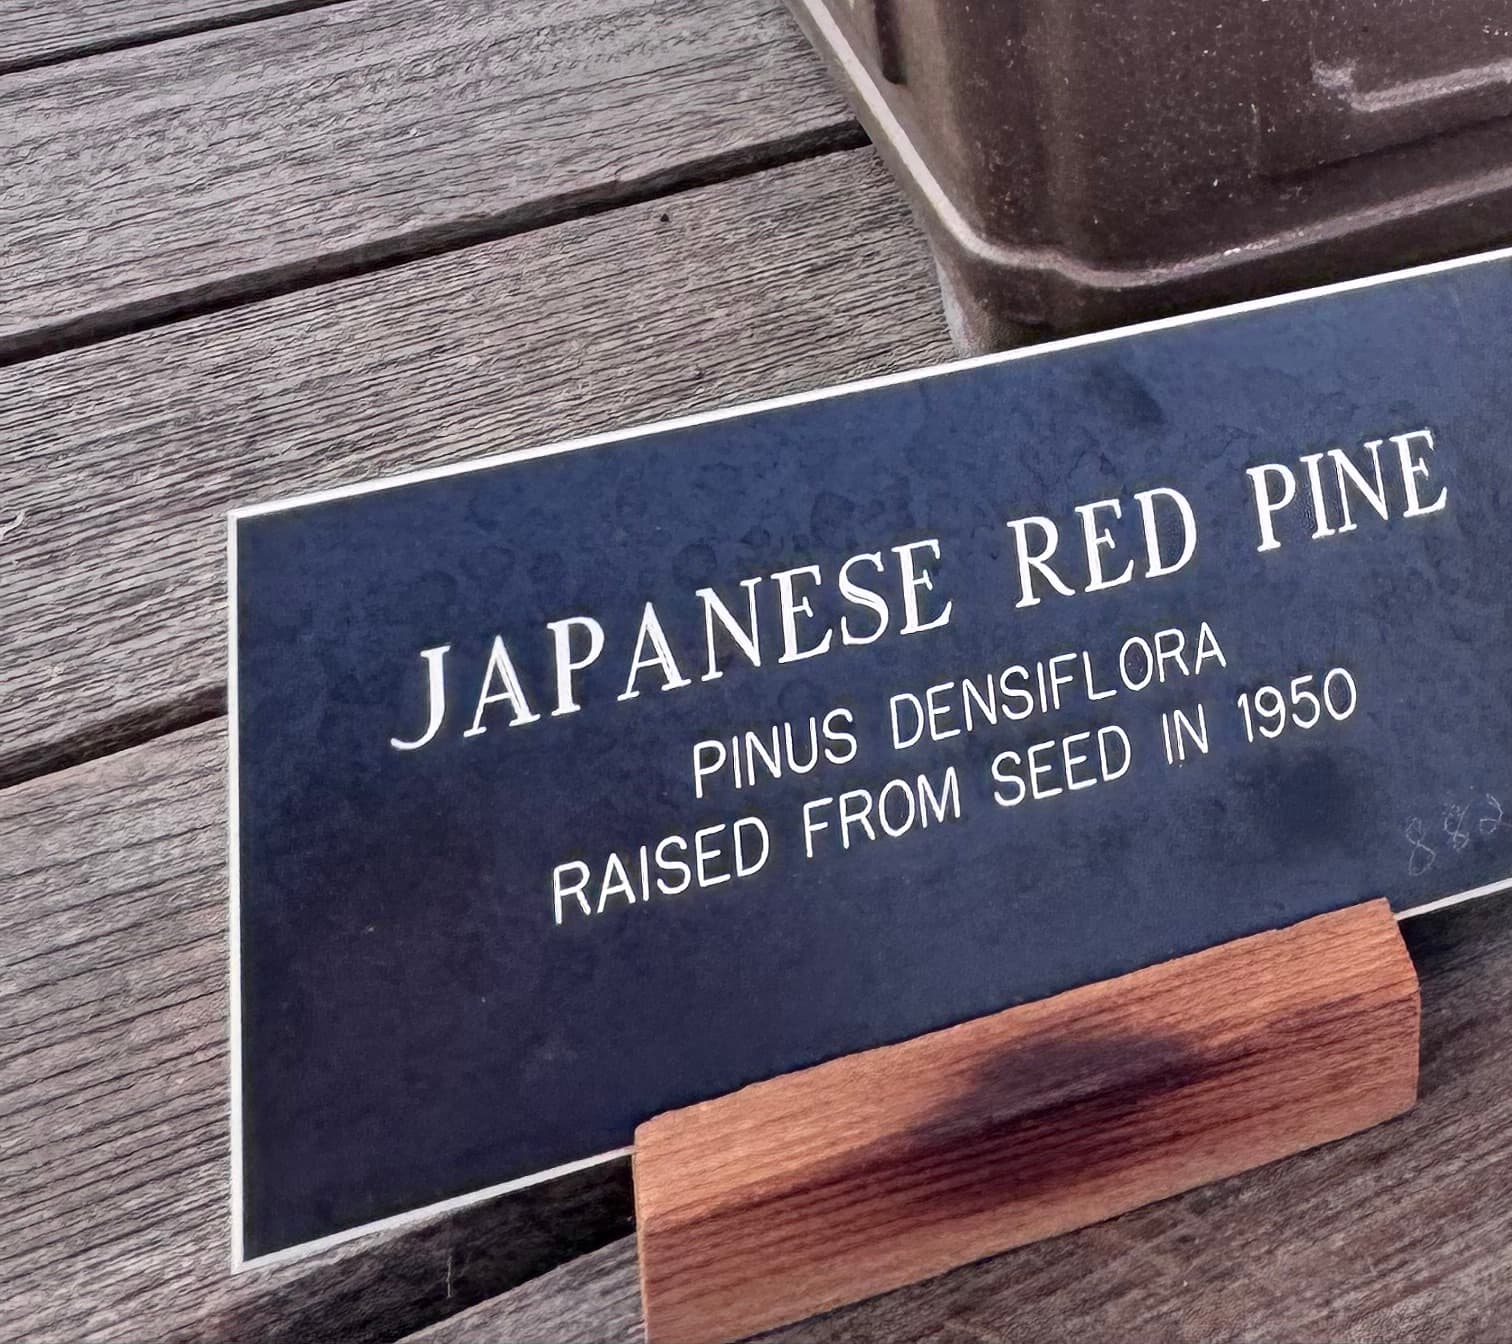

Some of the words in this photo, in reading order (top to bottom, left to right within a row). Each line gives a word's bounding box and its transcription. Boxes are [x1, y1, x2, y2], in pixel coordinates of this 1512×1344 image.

[389, 537, 954, 751] JAPANESE
[1005, 486, 1198, 610] RED
[1244, 428, 1449, 554] PINE
[692, 707, 859, 800] PINUS
[888, 620, 1228, 751] DENSIFLORA
[552, 815, 771, 926] RAISED
[802, 765, 962, 859] FROM
[990, 724, 1132, 808] SEED
[1161, 702, 1210, 766] IN
[1236, 666, 1358, 744] 1950
